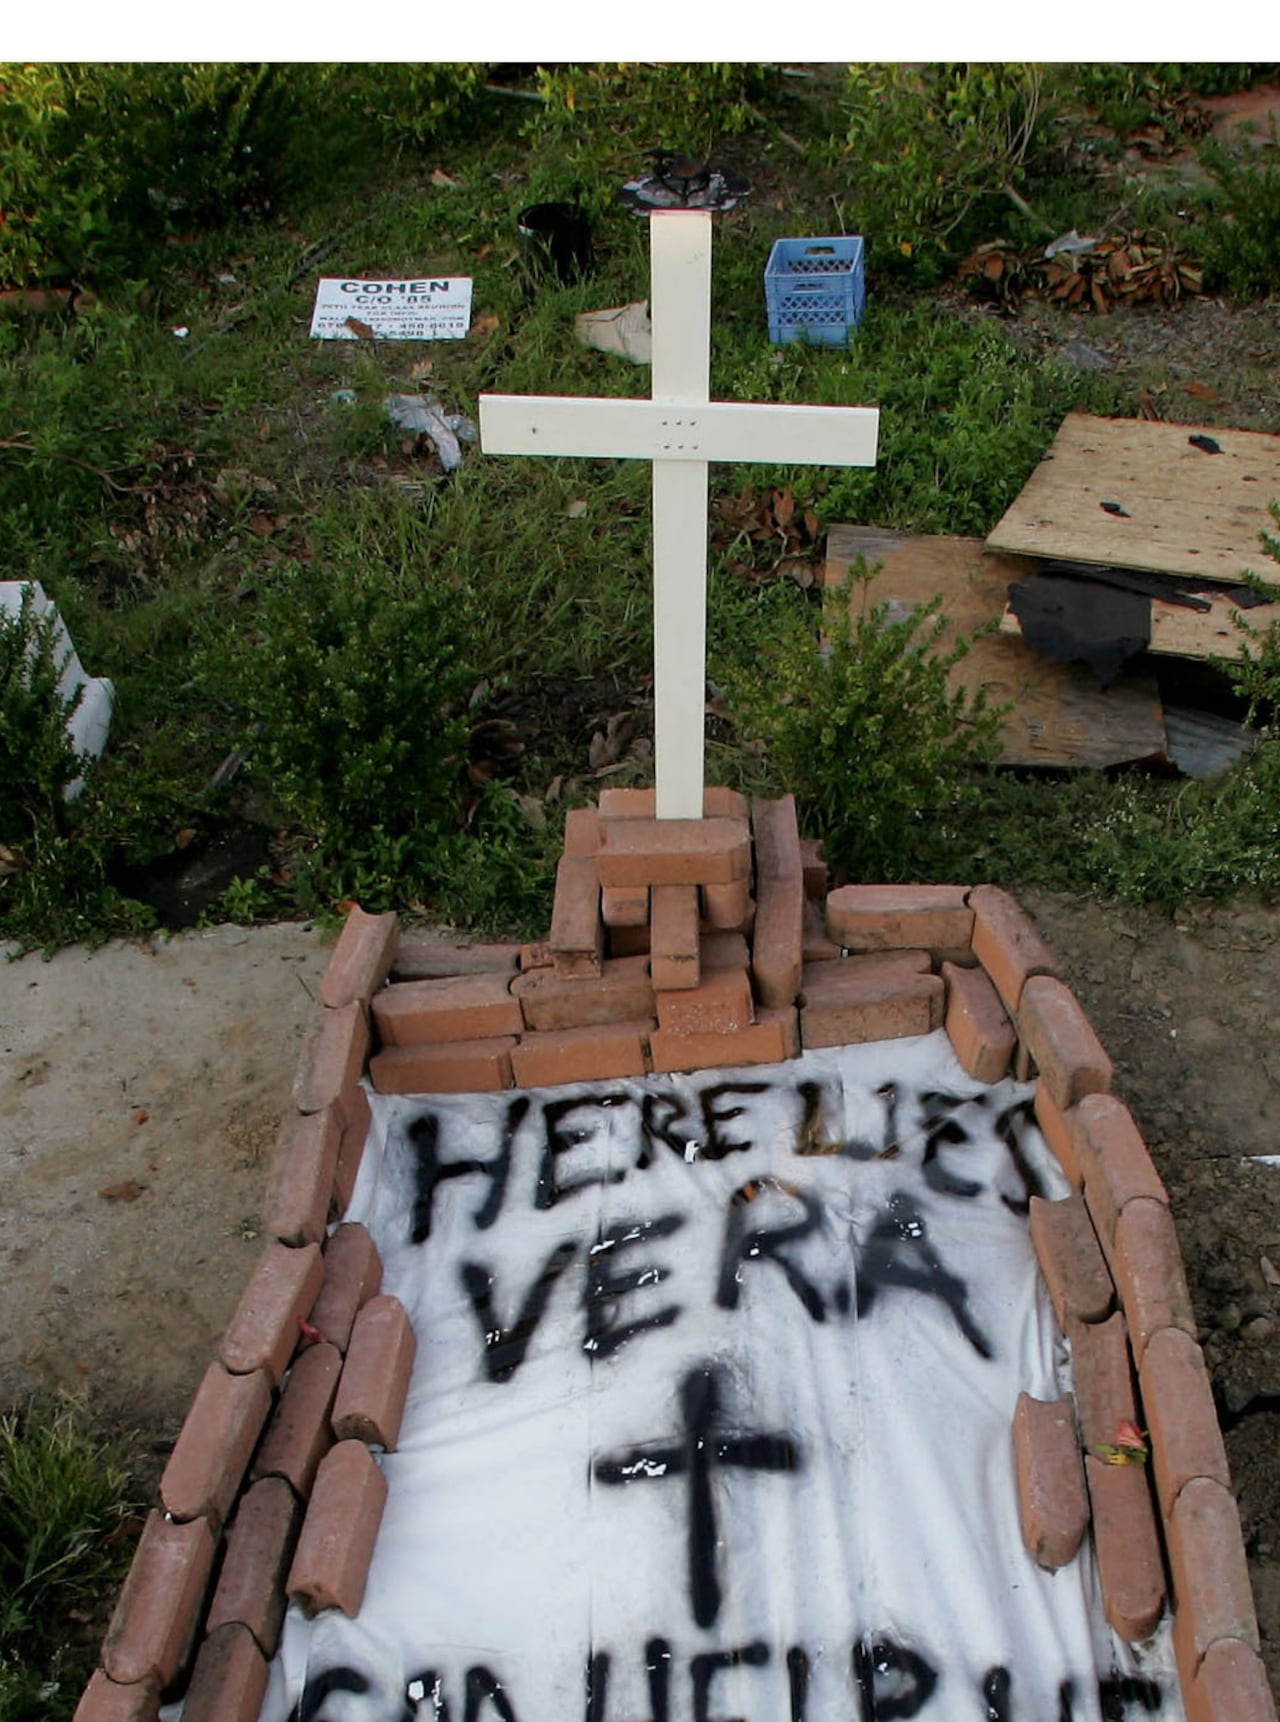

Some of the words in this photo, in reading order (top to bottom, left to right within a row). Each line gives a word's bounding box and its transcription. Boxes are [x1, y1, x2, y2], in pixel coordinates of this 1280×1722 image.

[340, 280, 450, 294] COHEN
[355, 295, 392, 304] C/O
[408, 1080, 772, 1245] HERE
[460, 1175, 995, 1383] VERA
